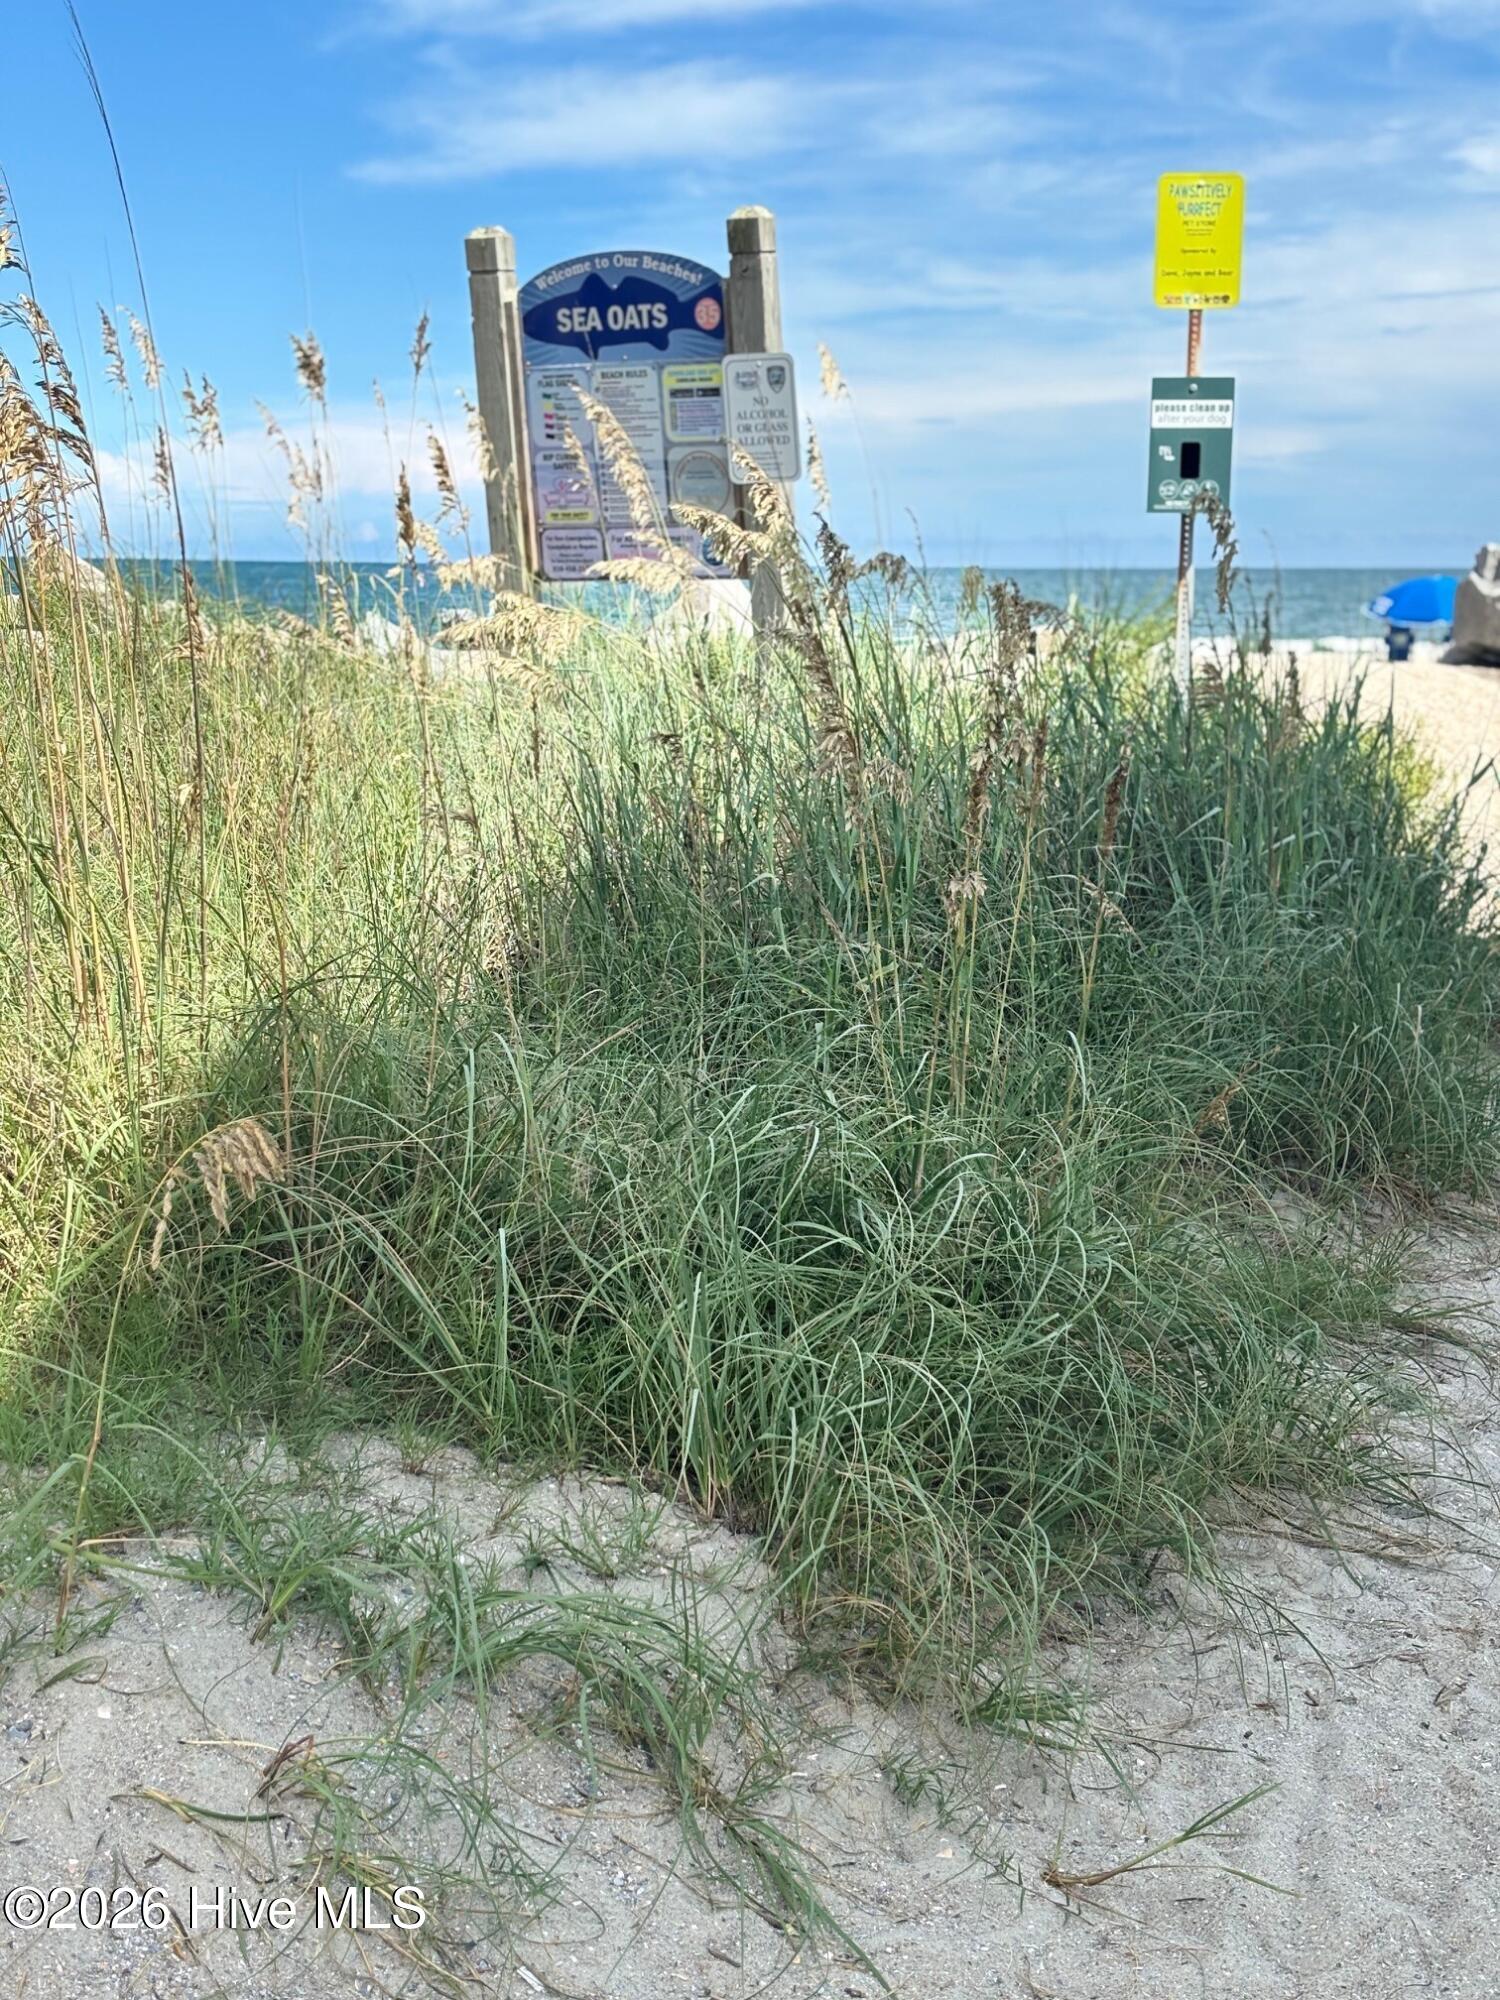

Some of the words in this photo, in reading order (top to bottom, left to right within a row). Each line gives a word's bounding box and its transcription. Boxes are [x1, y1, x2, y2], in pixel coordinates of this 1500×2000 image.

[534, 261, 592, 291] Welcome
[595, 257, 610, 270] to
[613, 254, 640, 269] Our
[642, 255, 703, 286] Beaches!
[556, 306, 603, 333] SEA
[607, 303, 669, 331] OATS
[601, 371, 624, 379] BEACH
[625, 369, 648, 378] RULES
[753, 396, 769, 407] NO
[1155, 403, 1187, 413] please
[1189, 402, 1216, 412] clean
[1218, 404, 1230, 413] up
[736, 408, 788, 419] ALCOHOL
[1157, 413, 1180, 423] after
[1182, 415, 1204, 424] your
[737, 423, 752, 433] OR
[754, 422, 789, 433] GLASS
[738, 435, 791, 446] ALLOWED
